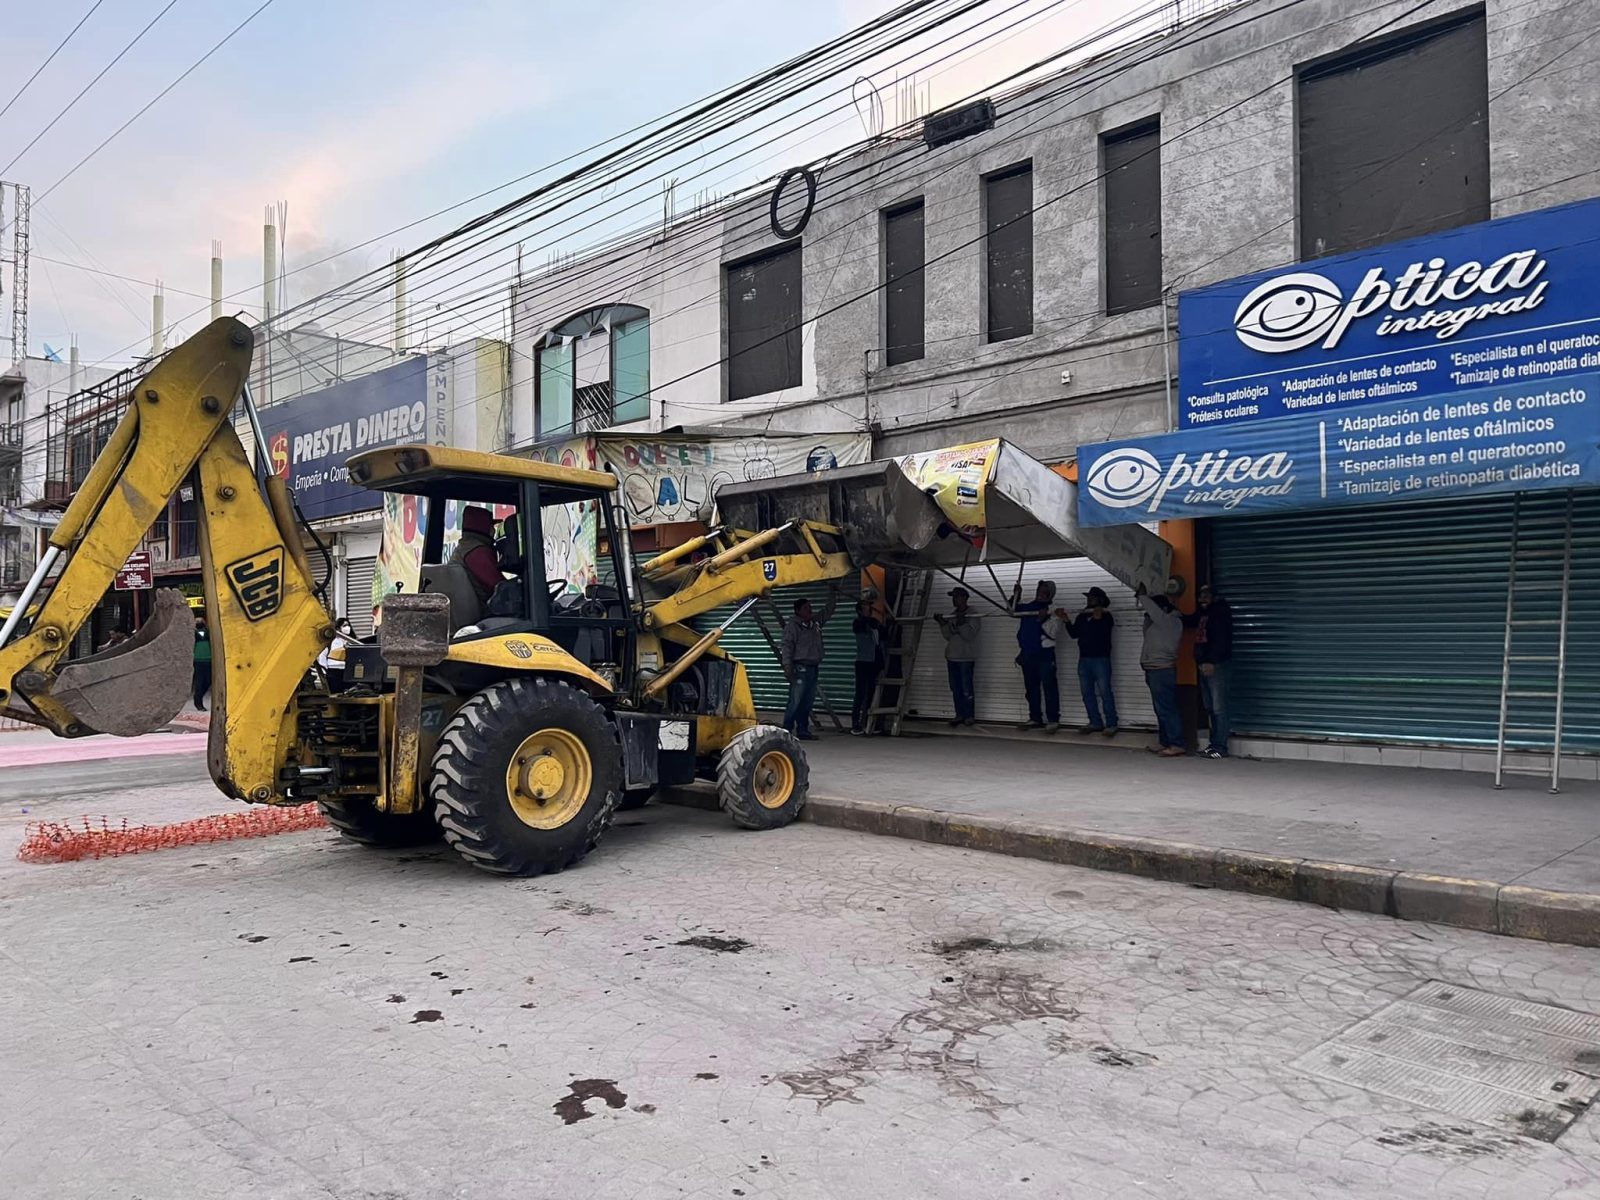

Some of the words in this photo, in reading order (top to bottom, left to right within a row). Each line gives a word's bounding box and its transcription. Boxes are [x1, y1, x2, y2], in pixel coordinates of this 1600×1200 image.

[1376, 281, 1548, 339] integral
[1520, 345, 1534, 356] en
[1537, 340, 1547, 354] el
[1336, 372, 1348, 384] de
[1350, 369, 1378, 382] lentes
[1379, 365, 1392, 377] de
[1394, 358, 1437, 375] contacto
[1502, 365, 1516, 378] de
[1226, 385, 1269, 403] patológica
[1325, 391, 1336, 404] de
[1338, 388, 1365, 401] lentes
[1367, 381, 1418, 397] oftálmicos
[1423, 405, 1441, 422] de
[1444, 400, 1489, 419] lentes
[1493, 396, 1512, 412] de
[1516, 388, 1586, 410] contacto
[1224, 404, 1259, 419] oculares
[293, 421, 352, 465] PRESTA
[356, 400, 426, 449] DINERO
[1404, 429, 1422, 446] de
[1426, 423, 1470, 443] lentes
[1474, 416, 1555, 438] oftálmicos
[1429, 451, 1447, 465] en
[1451, 447, 1464, 463] el
[1468, 440, 1566, 464] queratocono
[295, 471, 322, 491] Empeña
[1405, 473, 1422, 490] de
[1426, 465, 1504, 488] retinopatía
[1509, 461, 1581, 481] diabética
[1184, 476, 1296, 510] integral
[764, 562, 775, 572] 27
[233, 558, 279, 616] JCB
[422, 710, 443, 727] 27
